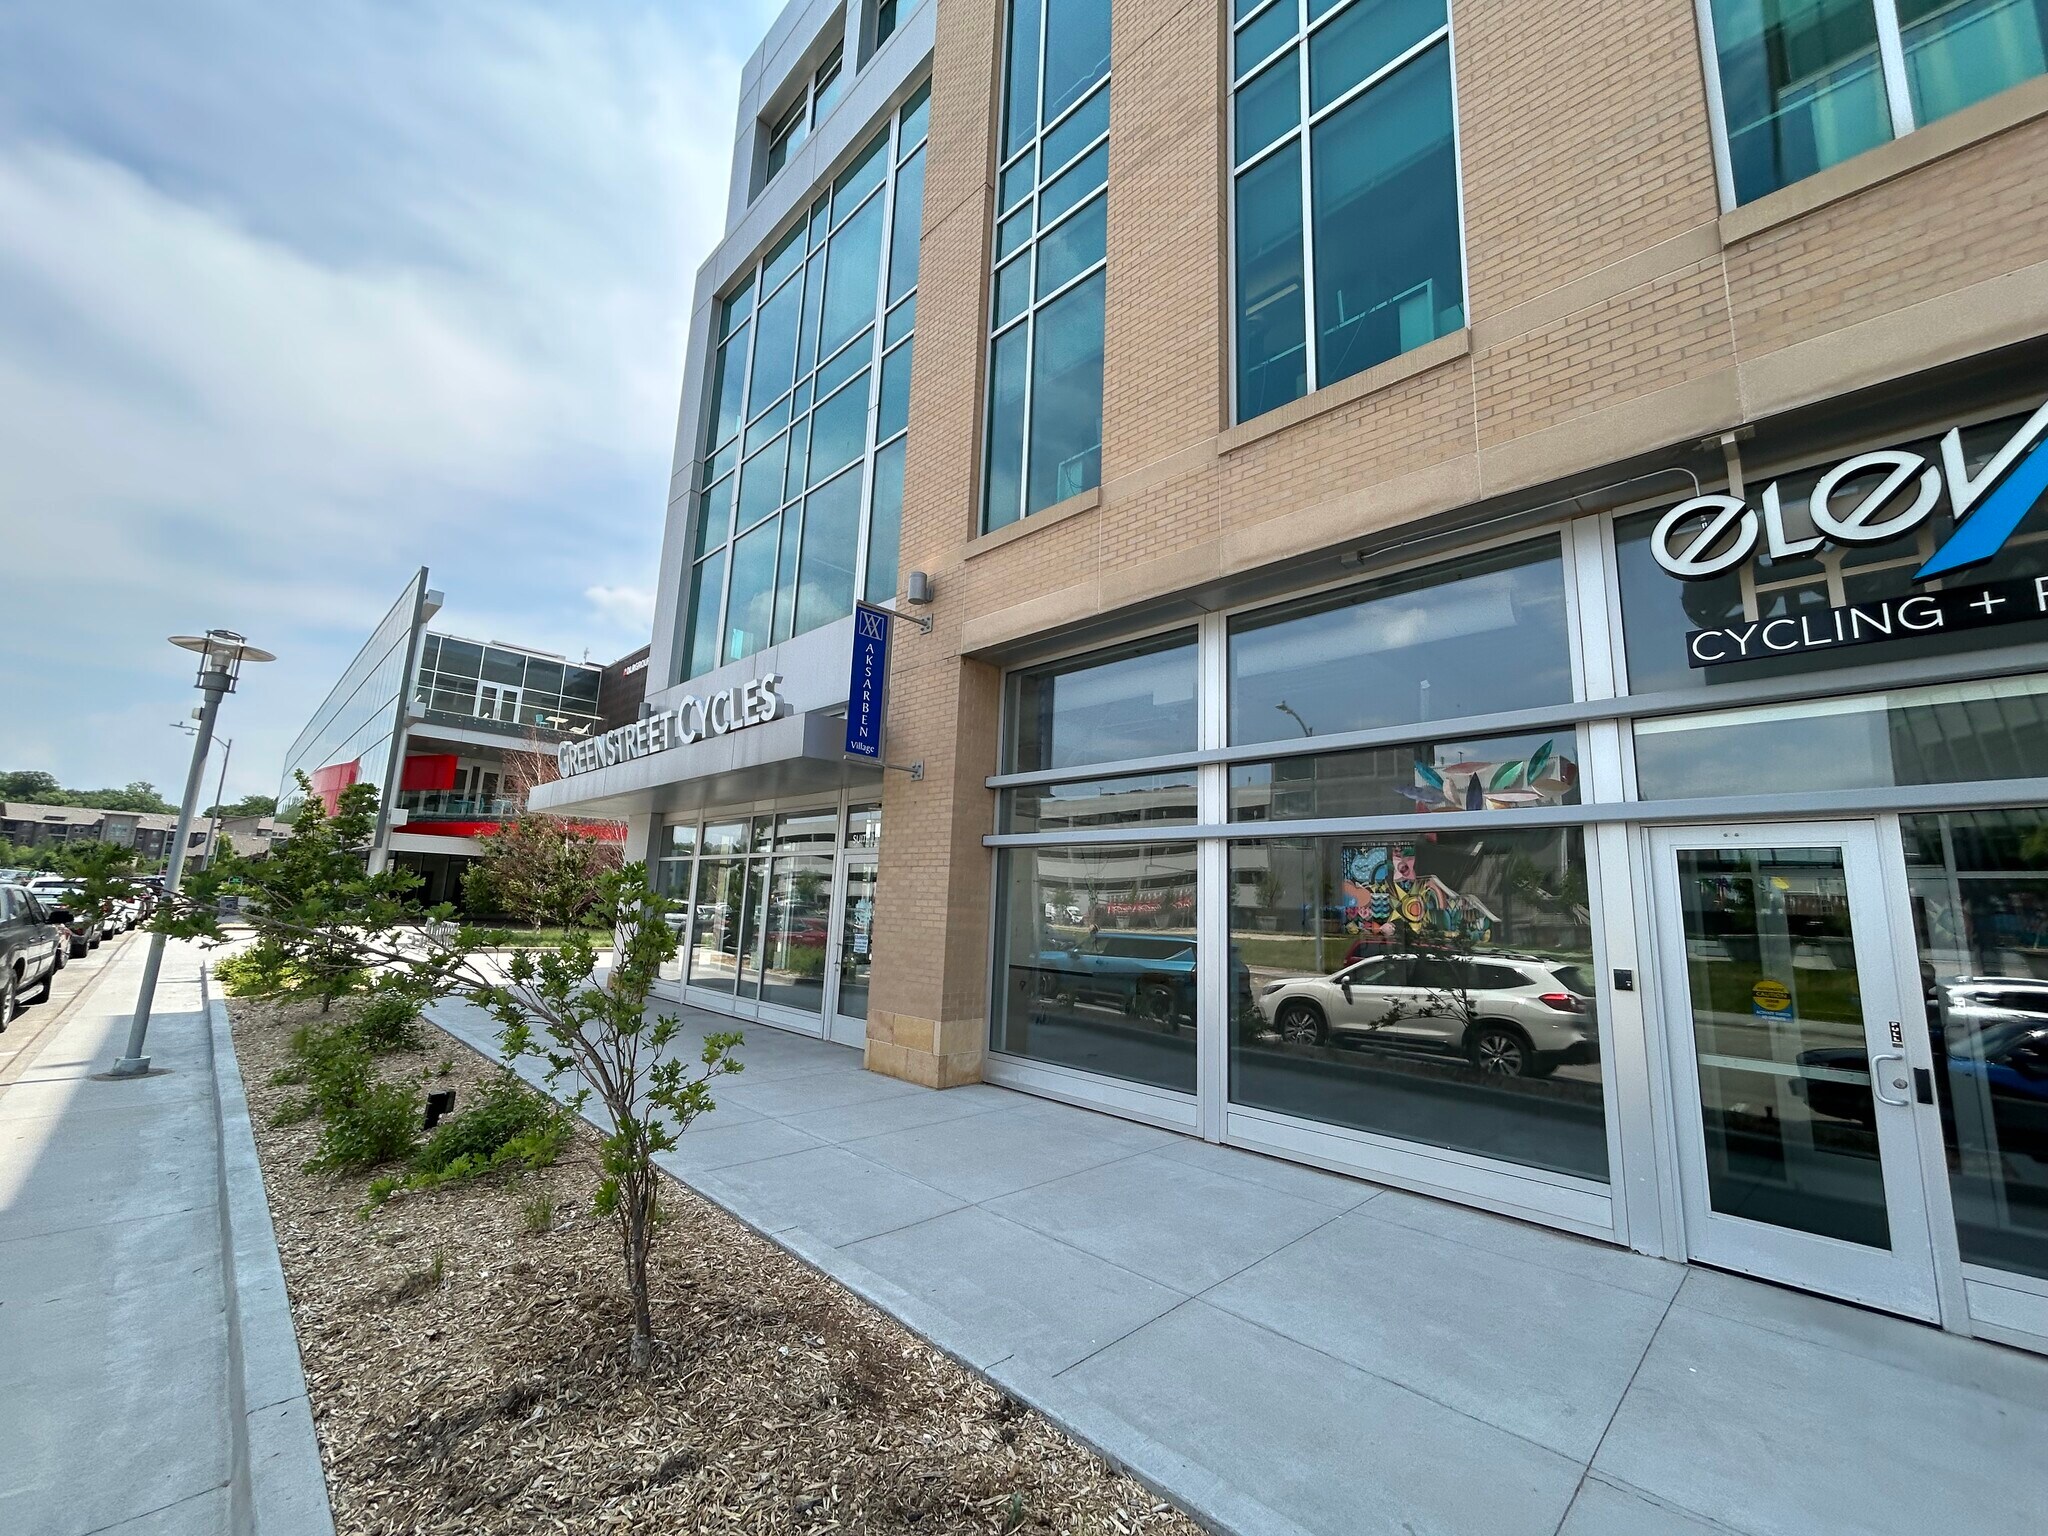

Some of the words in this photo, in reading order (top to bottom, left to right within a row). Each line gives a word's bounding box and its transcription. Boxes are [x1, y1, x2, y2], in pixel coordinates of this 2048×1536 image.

[1692, 596, 1944, 661] CYCLING
[557, 709, 679, 778] GREENSTREET
[677, 672, 784, 744] CYCLES
[859, 643, 875, 738] AKSARBEN
[850, 741, 875, 754] Village
